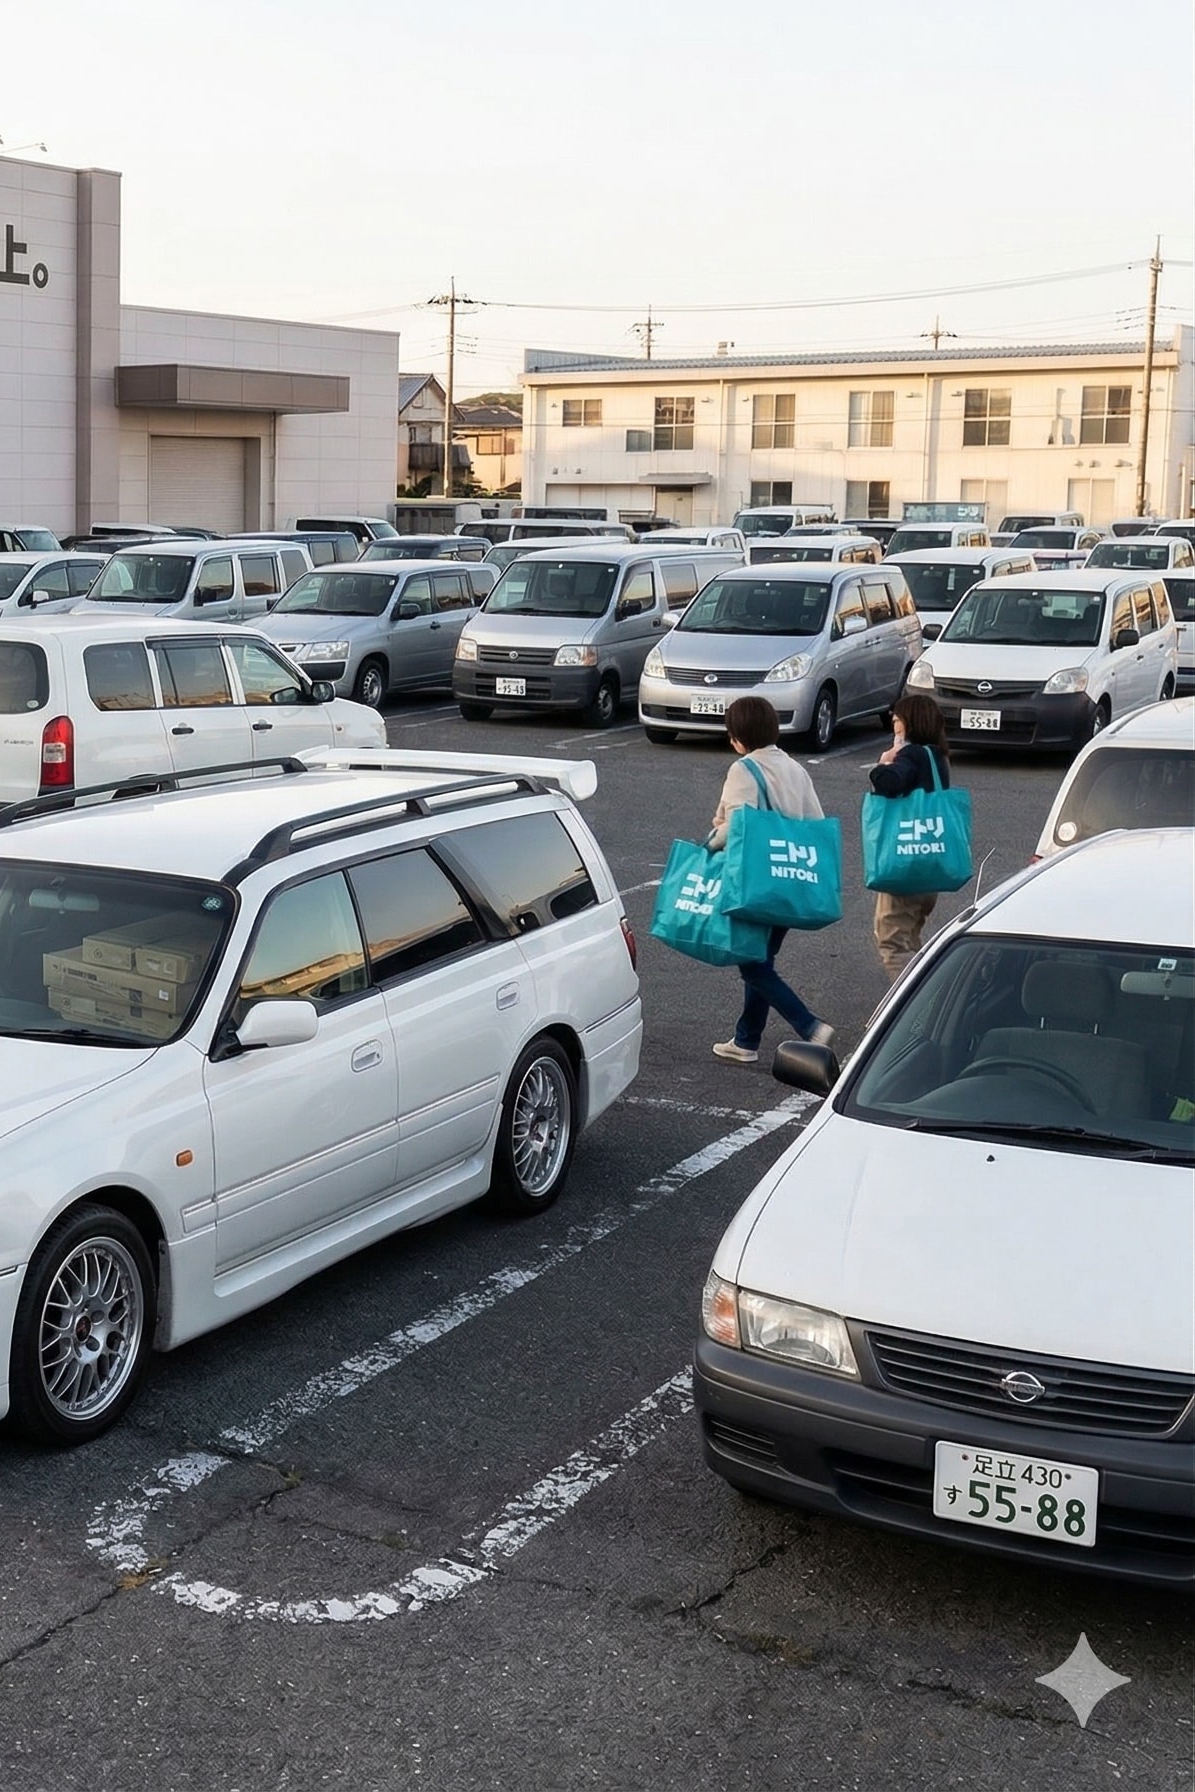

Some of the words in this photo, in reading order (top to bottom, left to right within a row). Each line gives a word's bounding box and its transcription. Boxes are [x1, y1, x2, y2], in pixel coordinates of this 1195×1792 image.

[897, 816, 944, 839] ニトリ
[770, 839, 818, 868] ニトリ
[897, 843, 945, 855] NITORI
[681, 873, 722, 899] ニトリ
[771, 866, 818, 884] NITORI
[943, 1485, 962, 1505] す
[968, 1479, 1086, 1537] 55-88
